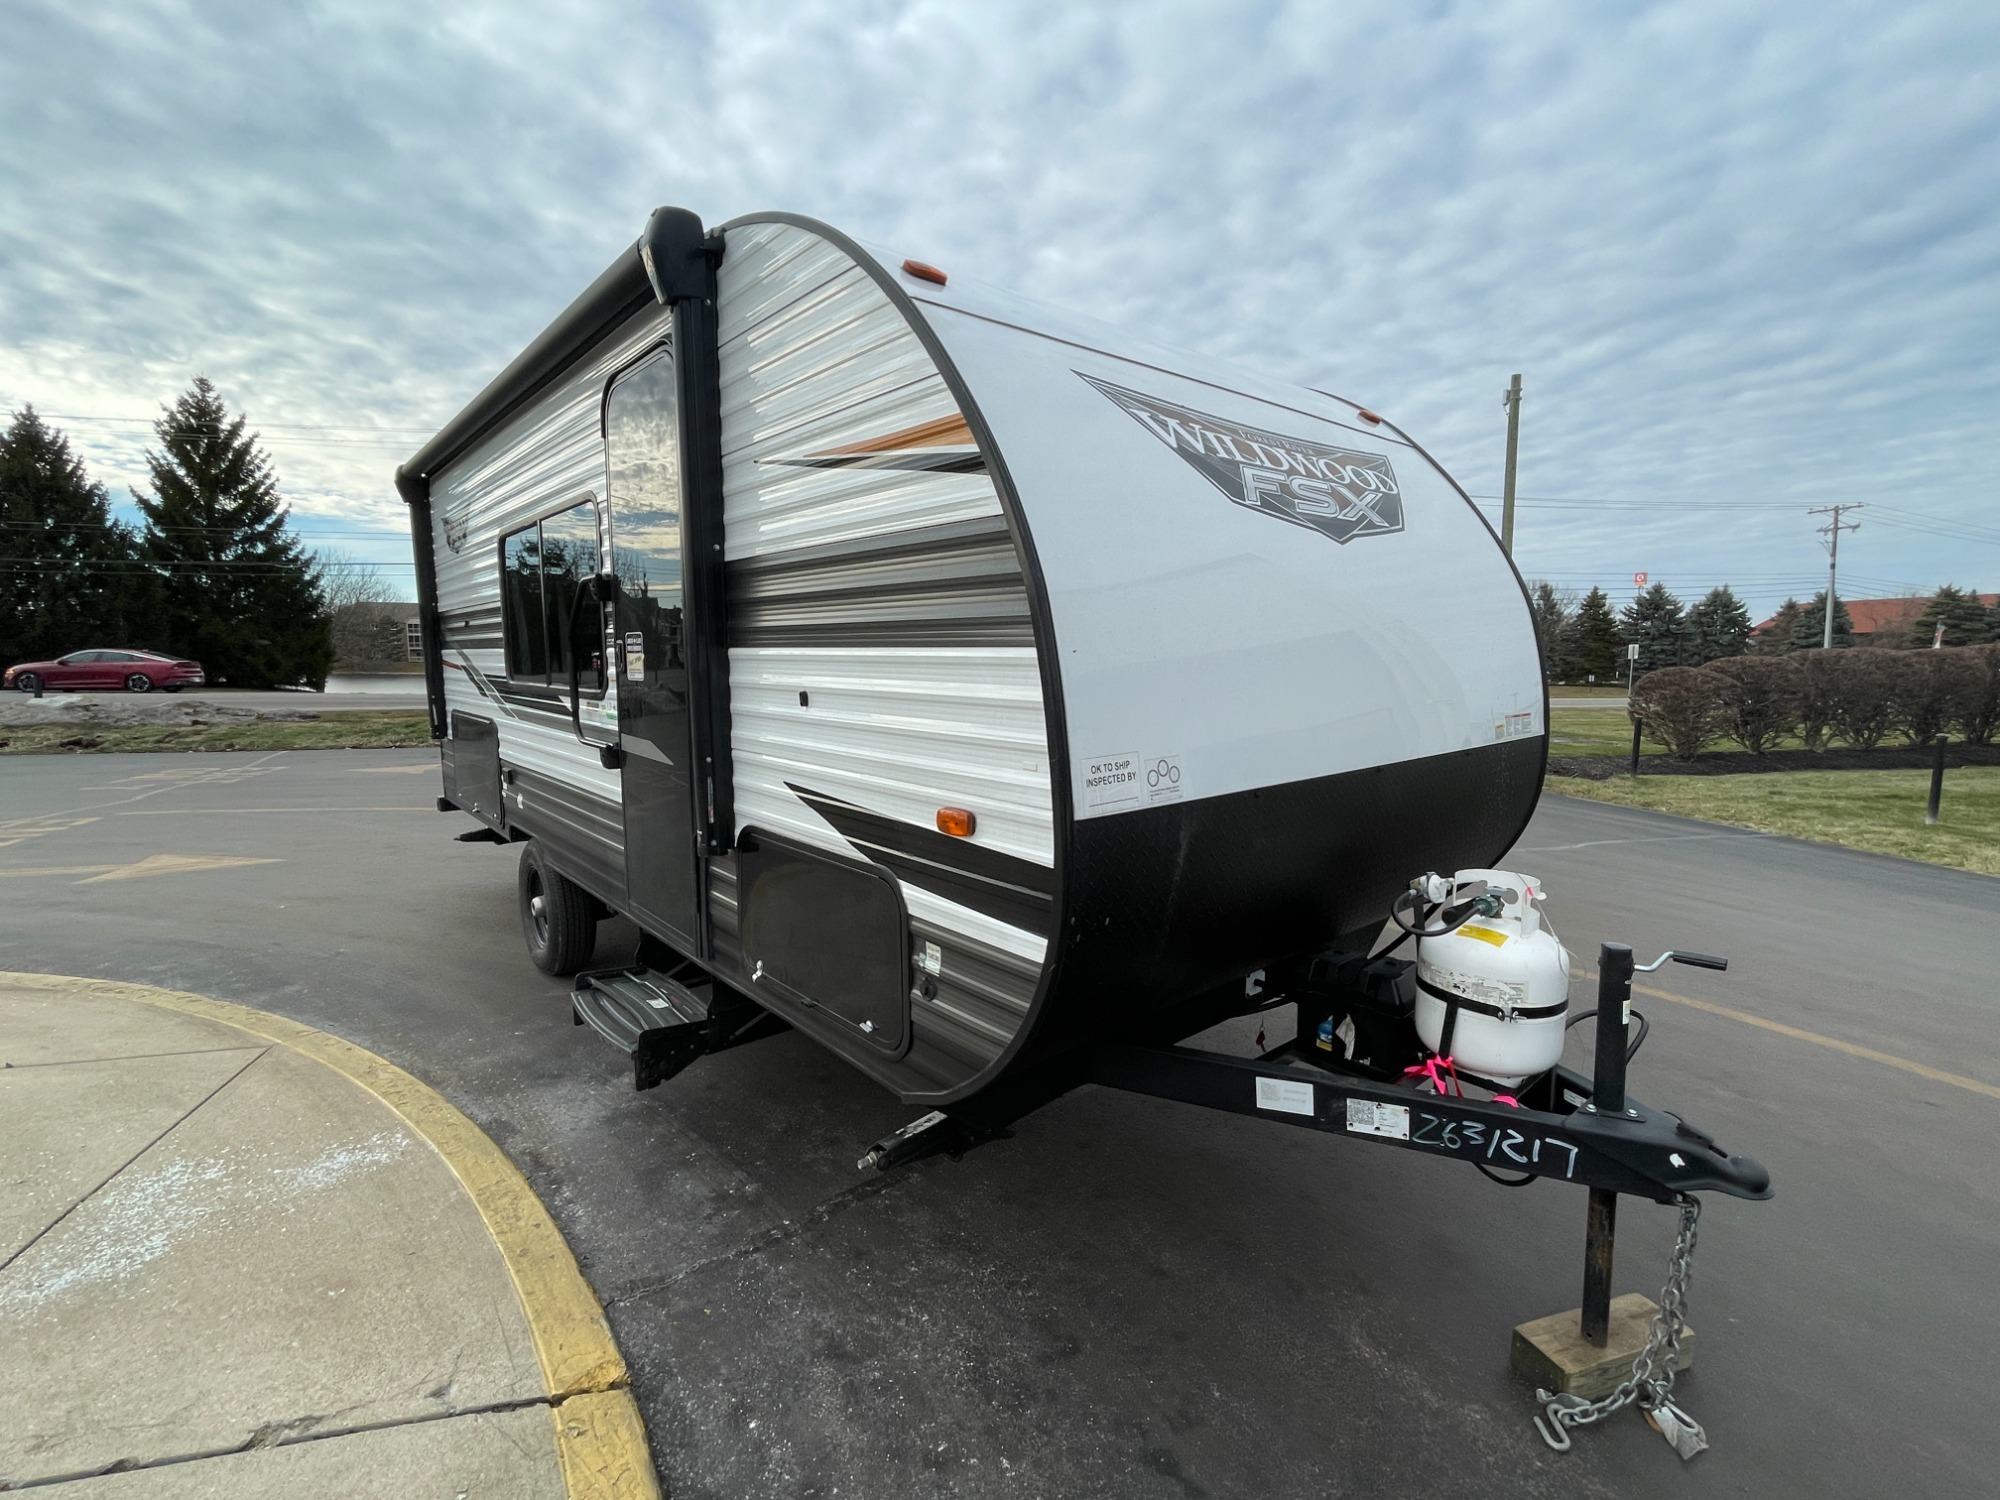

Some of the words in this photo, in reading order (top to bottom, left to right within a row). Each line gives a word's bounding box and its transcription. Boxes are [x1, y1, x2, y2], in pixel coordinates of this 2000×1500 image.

[1129, 407, 1399, 495] WILDWOOD
[1239, 463, 1391, 528] FSX
[1086, 774, 1125, 787] INSPECTED
[1127, 772, 1136, 781] BY
[1090, 764, 1102, 775] OK
[1103, 762, 1113, 772] TO
[1115, 760, 1130, 771] SHIP
